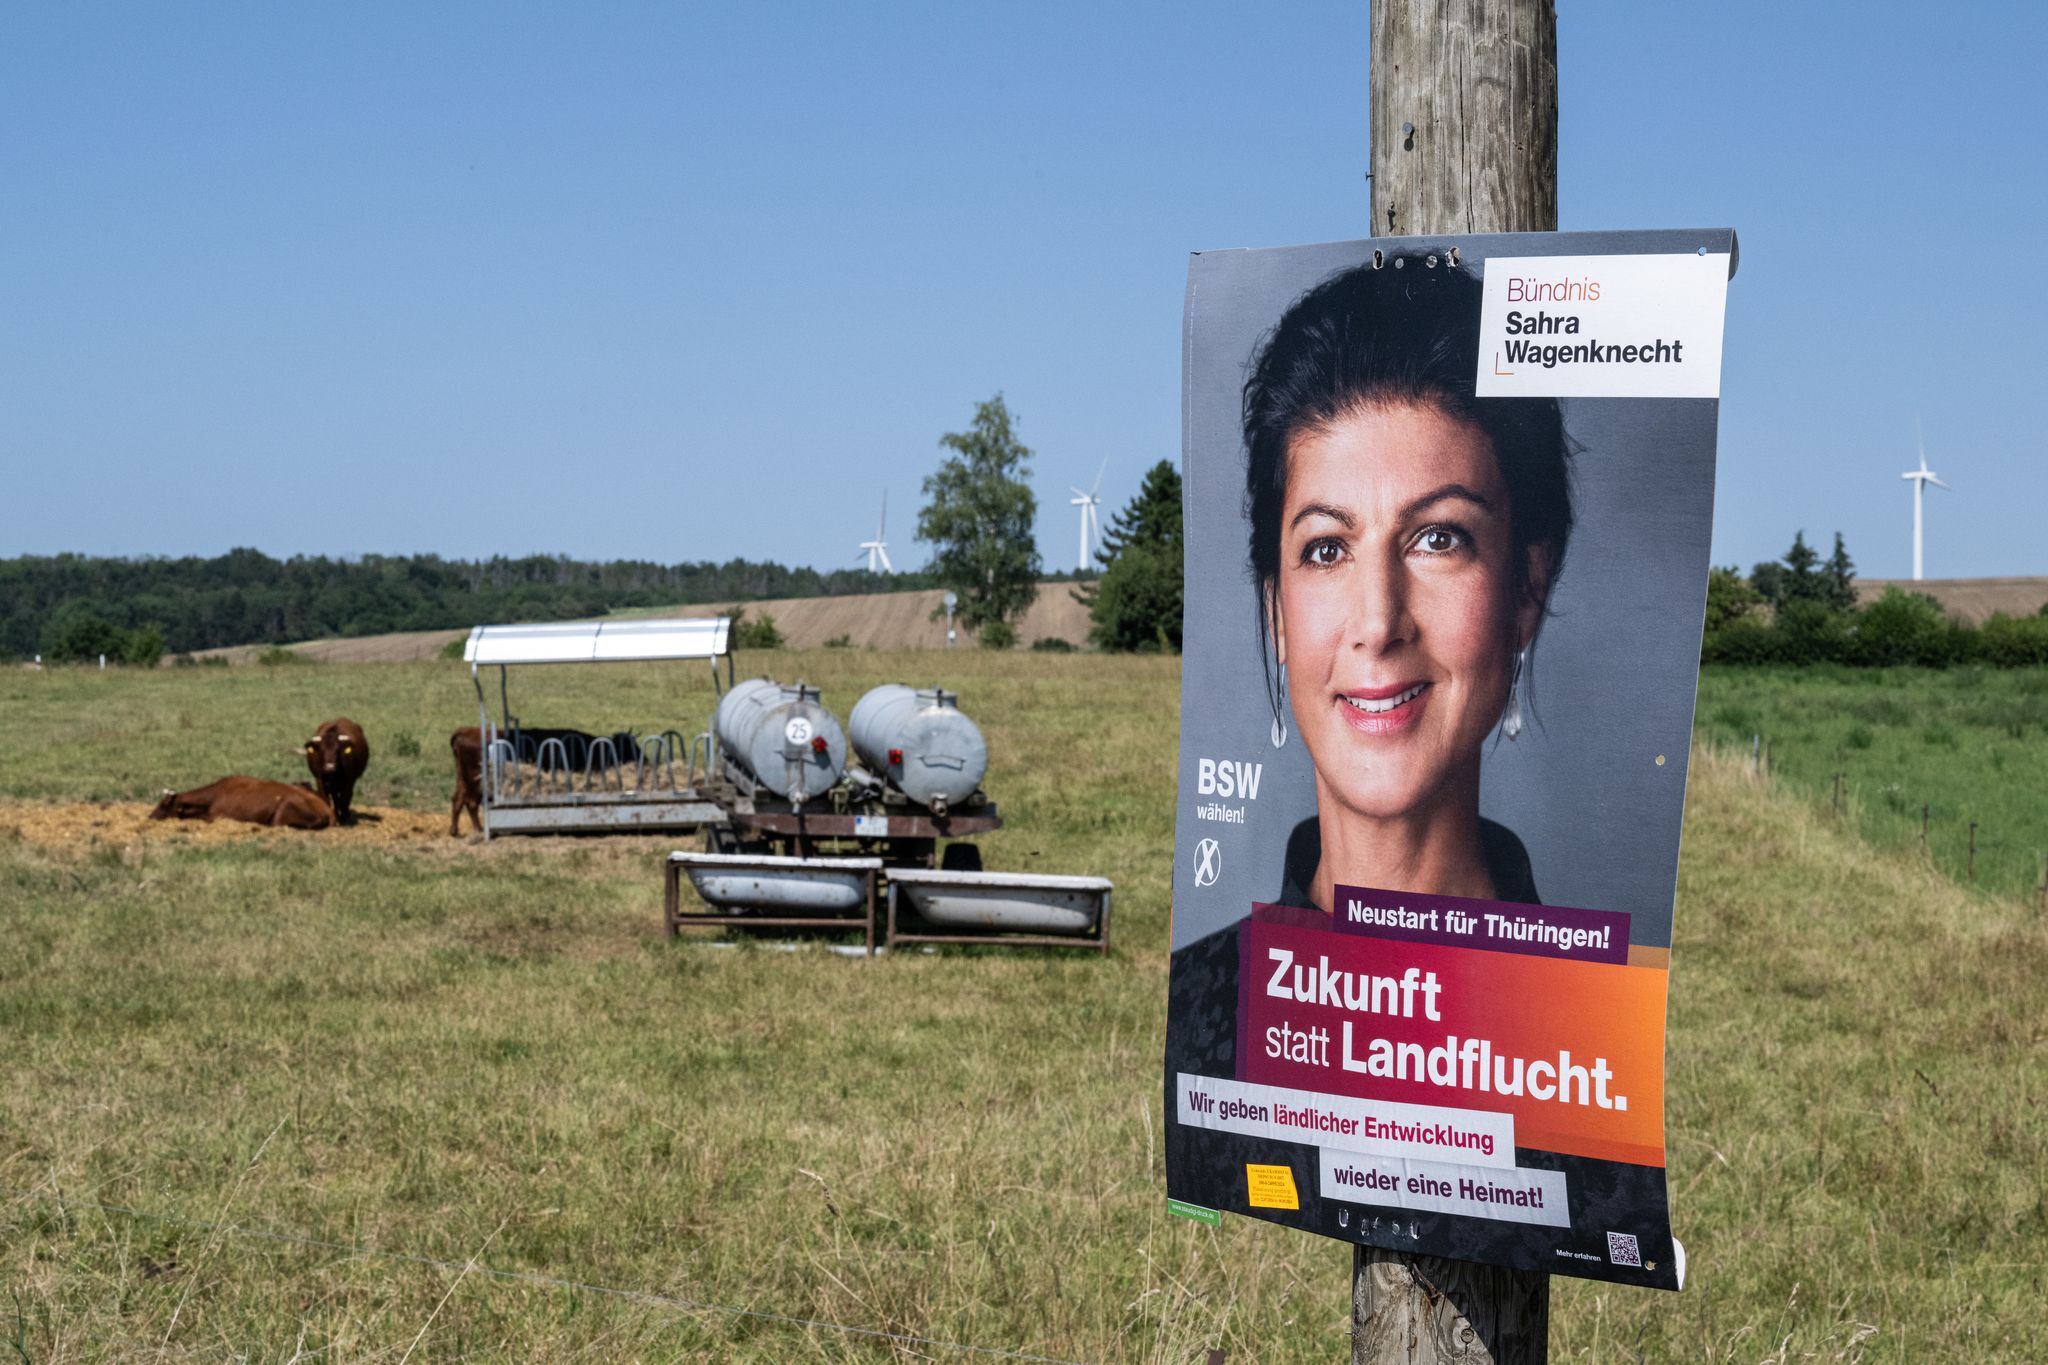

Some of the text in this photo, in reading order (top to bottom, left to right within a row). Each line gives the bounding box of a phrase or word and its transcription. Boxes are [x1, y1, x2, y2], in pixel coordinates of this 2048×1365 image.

[1507, 277, 1601, 302] Bündnis
[1505, 311, 1580, 335] Sahra
[1505, 339, 1683, 369] Wagenknecht
[792, 723, 807, 739] 25
[1198, 758, 1263, 800] BSW
[1197, 802, 1245, 824] wählen!
[1347, 899, 1611, 950] Neustart für Thüringen!
[1266, 947, 1442, 1022] Zukunft
[1265, 1020, 1628, 1112] statt Landflucht.
[1188, 1090, 1494, 1156] Wir geben ländlicher Entwicklung
[1334, 1165, 1544, 1209] wieder eine Heimat!
[1556, 1249, 1601, 1262] Mehr erfahren
